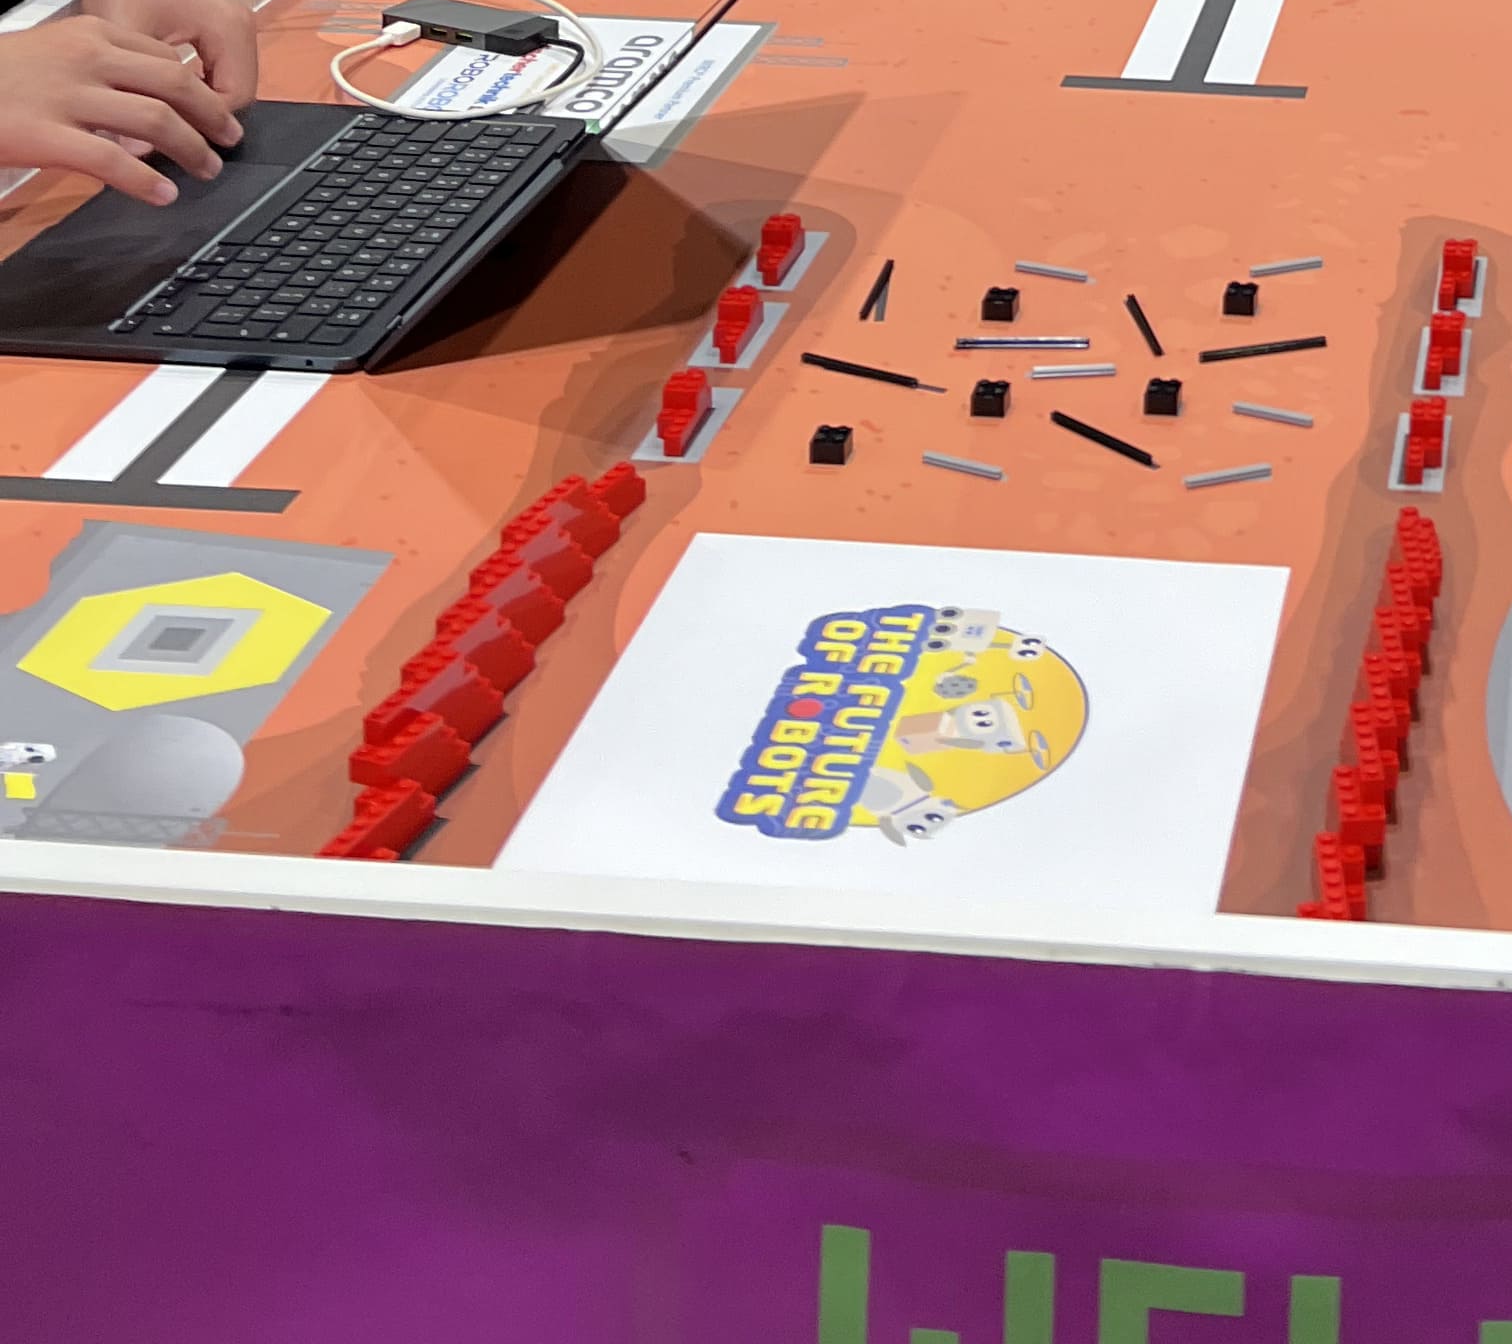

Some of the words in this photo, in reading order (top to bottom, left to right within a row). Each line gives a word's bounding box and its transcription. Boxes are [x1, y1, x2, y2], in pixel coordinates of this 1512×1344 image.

[565, 34, 664, 113] aramco
[814, 619, 868, 664] OF
[856, 612, 925, 675] THE
[784, 682, 892, 832] FUTURE
